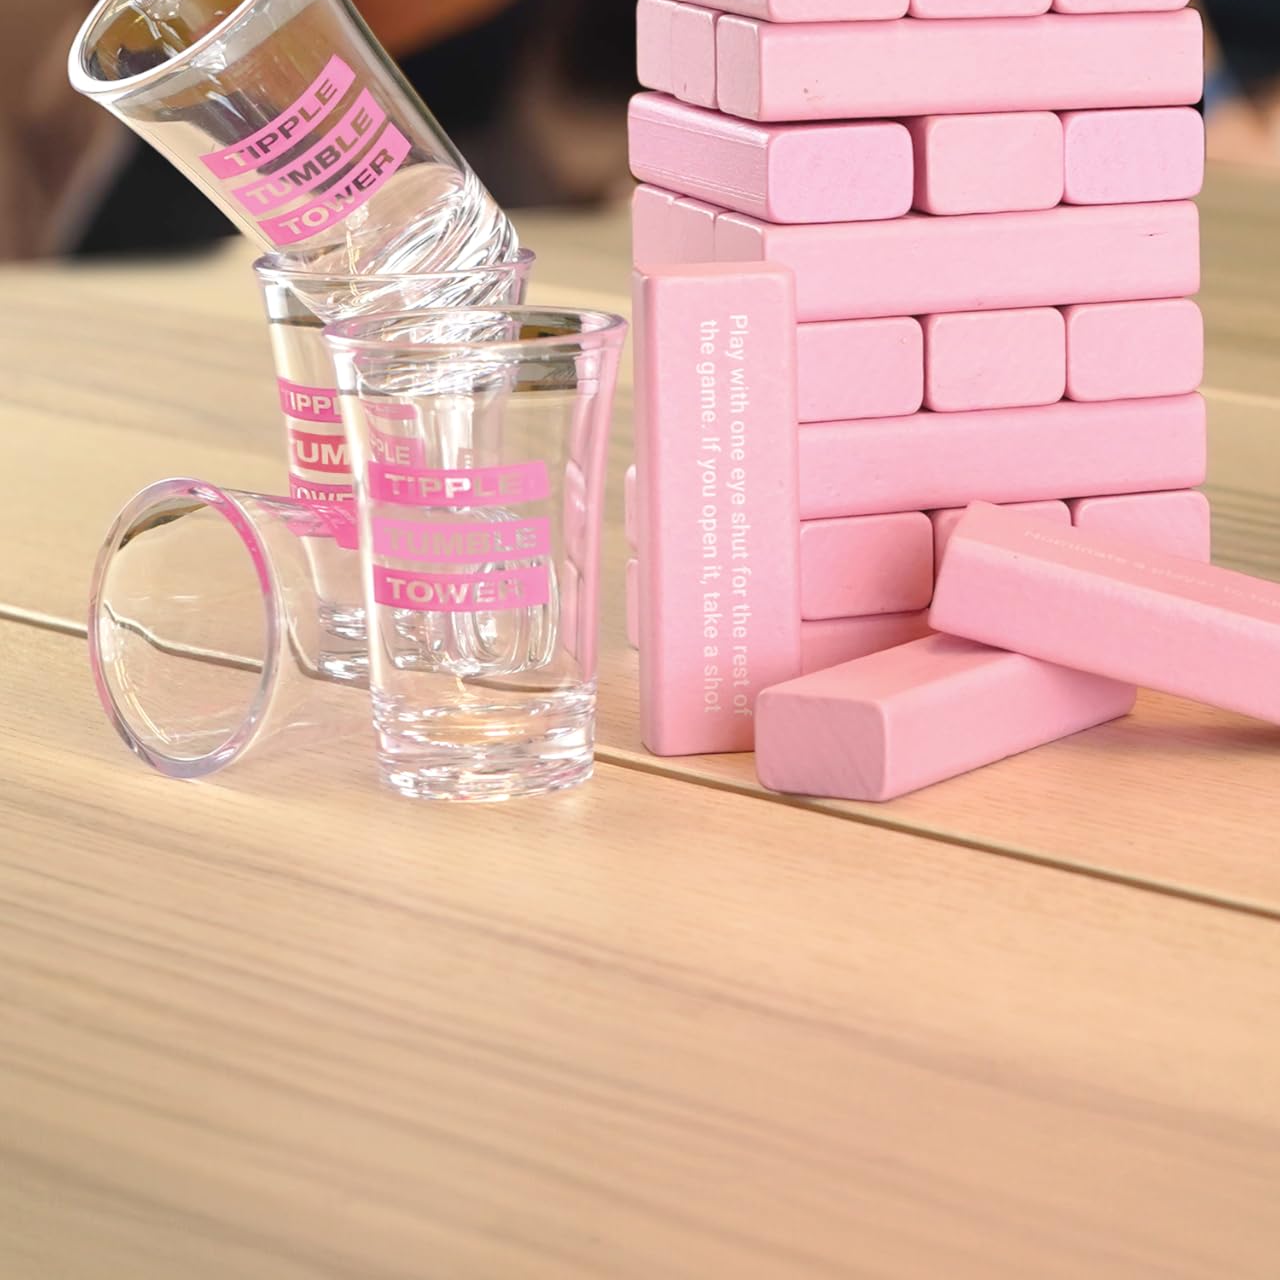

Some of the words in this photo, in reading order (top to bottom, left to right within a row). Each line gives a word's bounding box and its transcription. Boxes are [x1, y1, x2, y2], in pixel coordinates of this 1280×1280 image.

[224, 78, 338, 167] TIPPLE
[245, 106, 373, 205] TUMBLE
[278, 147, 395, 236] TOWER
[700, 319, 719, 355] the
[724, 314, 750, 360] Play
[695, 361, 717, 429] game.
[729, 368, 750, 413] with
[700, 436, 721, 452] If
[730, 420, 745, 461] one
[384, 473, 524, 499] TIPPLE
[696, 457, 717, 497] you
[725, 467, 746, 505] eye
[384, 527, 537, 557] TUMBLE
[698, 504, 718, 559] open
[731, 512, 752, 560] shut
[385, 576, 526, 604] TOWER
[699, 565, 721, 585] it,
[731, 566, 752, 597] for
[703, 592, 723, 639] take
[732, 604, 752, 639] the
[703, 646, 719, 657] a
[732, 645, 751, 688] rest
[703, 663, 723, 713] shot
[733, 693, 753, 716] of
